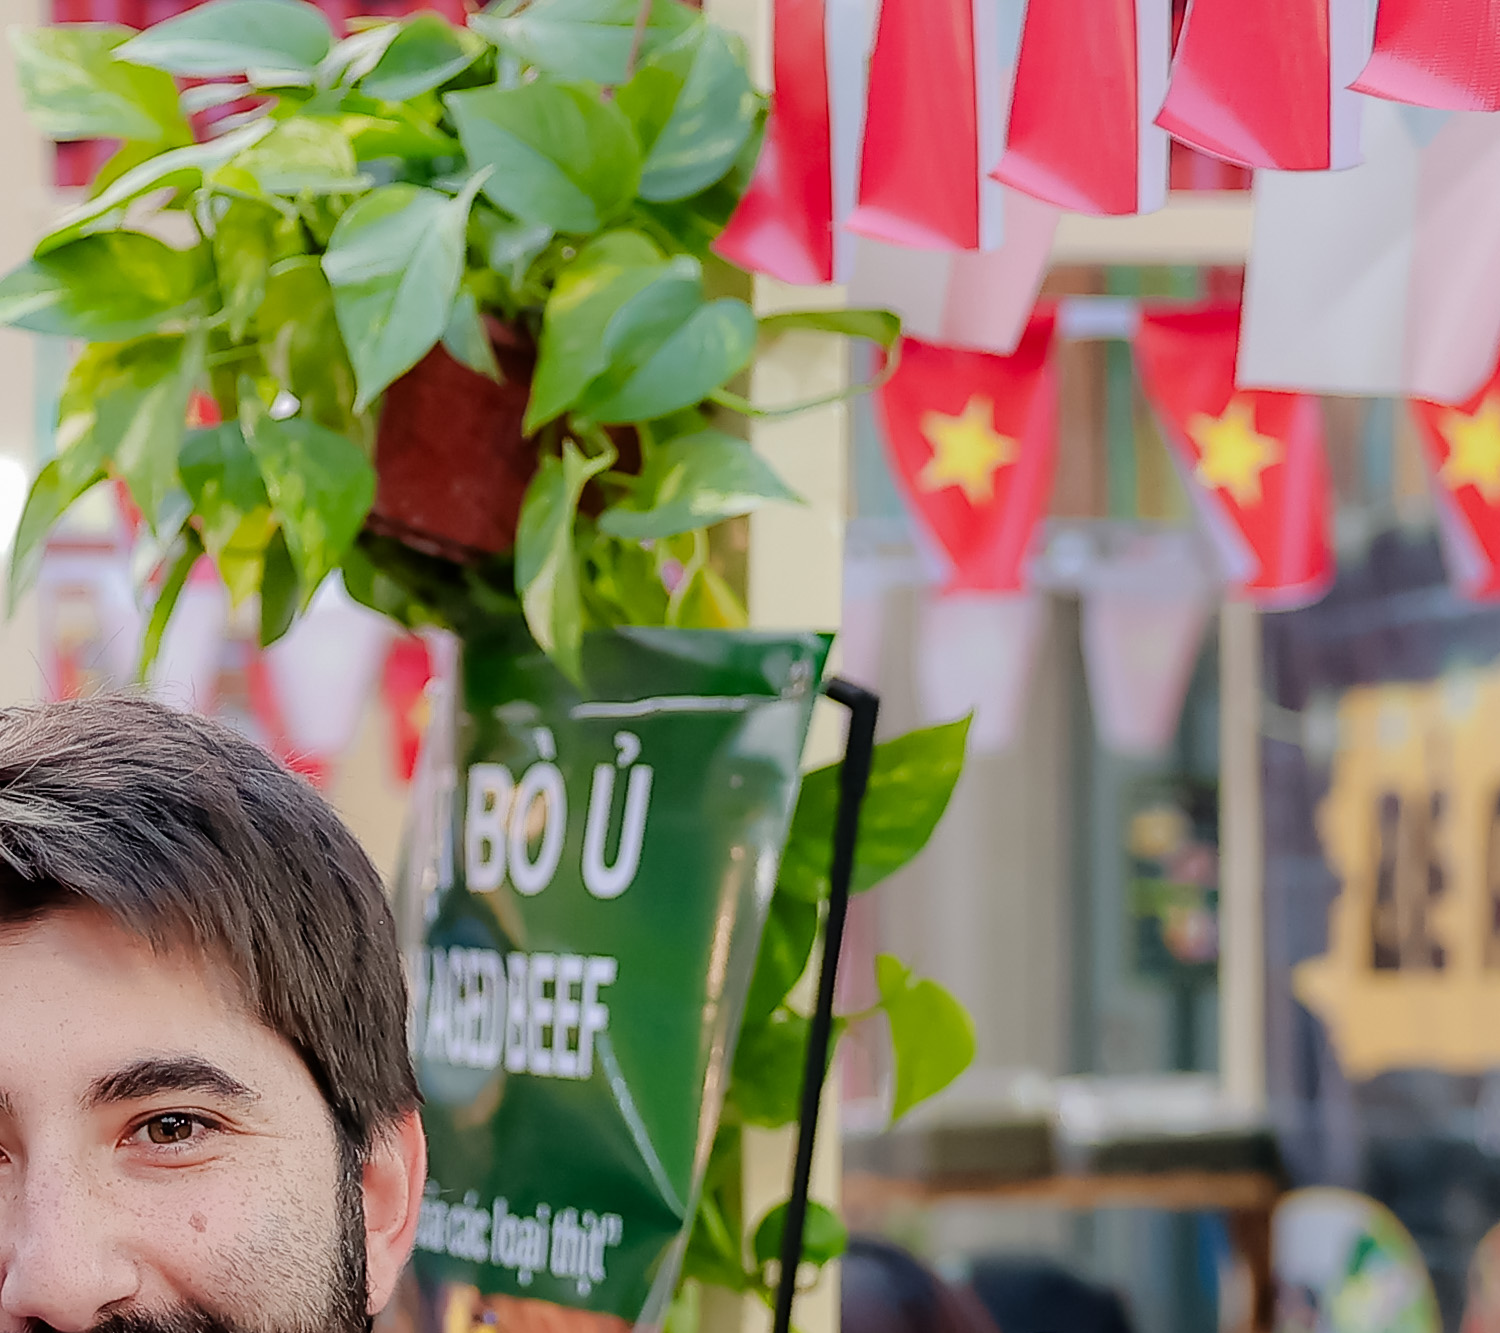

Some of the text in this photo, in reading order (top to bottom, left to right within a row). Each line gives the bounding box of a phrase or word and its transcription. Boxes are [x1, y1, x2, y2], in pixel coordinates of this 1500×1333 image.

[465, 726, 654, 901] BÒ Ủ
[505, 951, 618, 1080] BEEF
